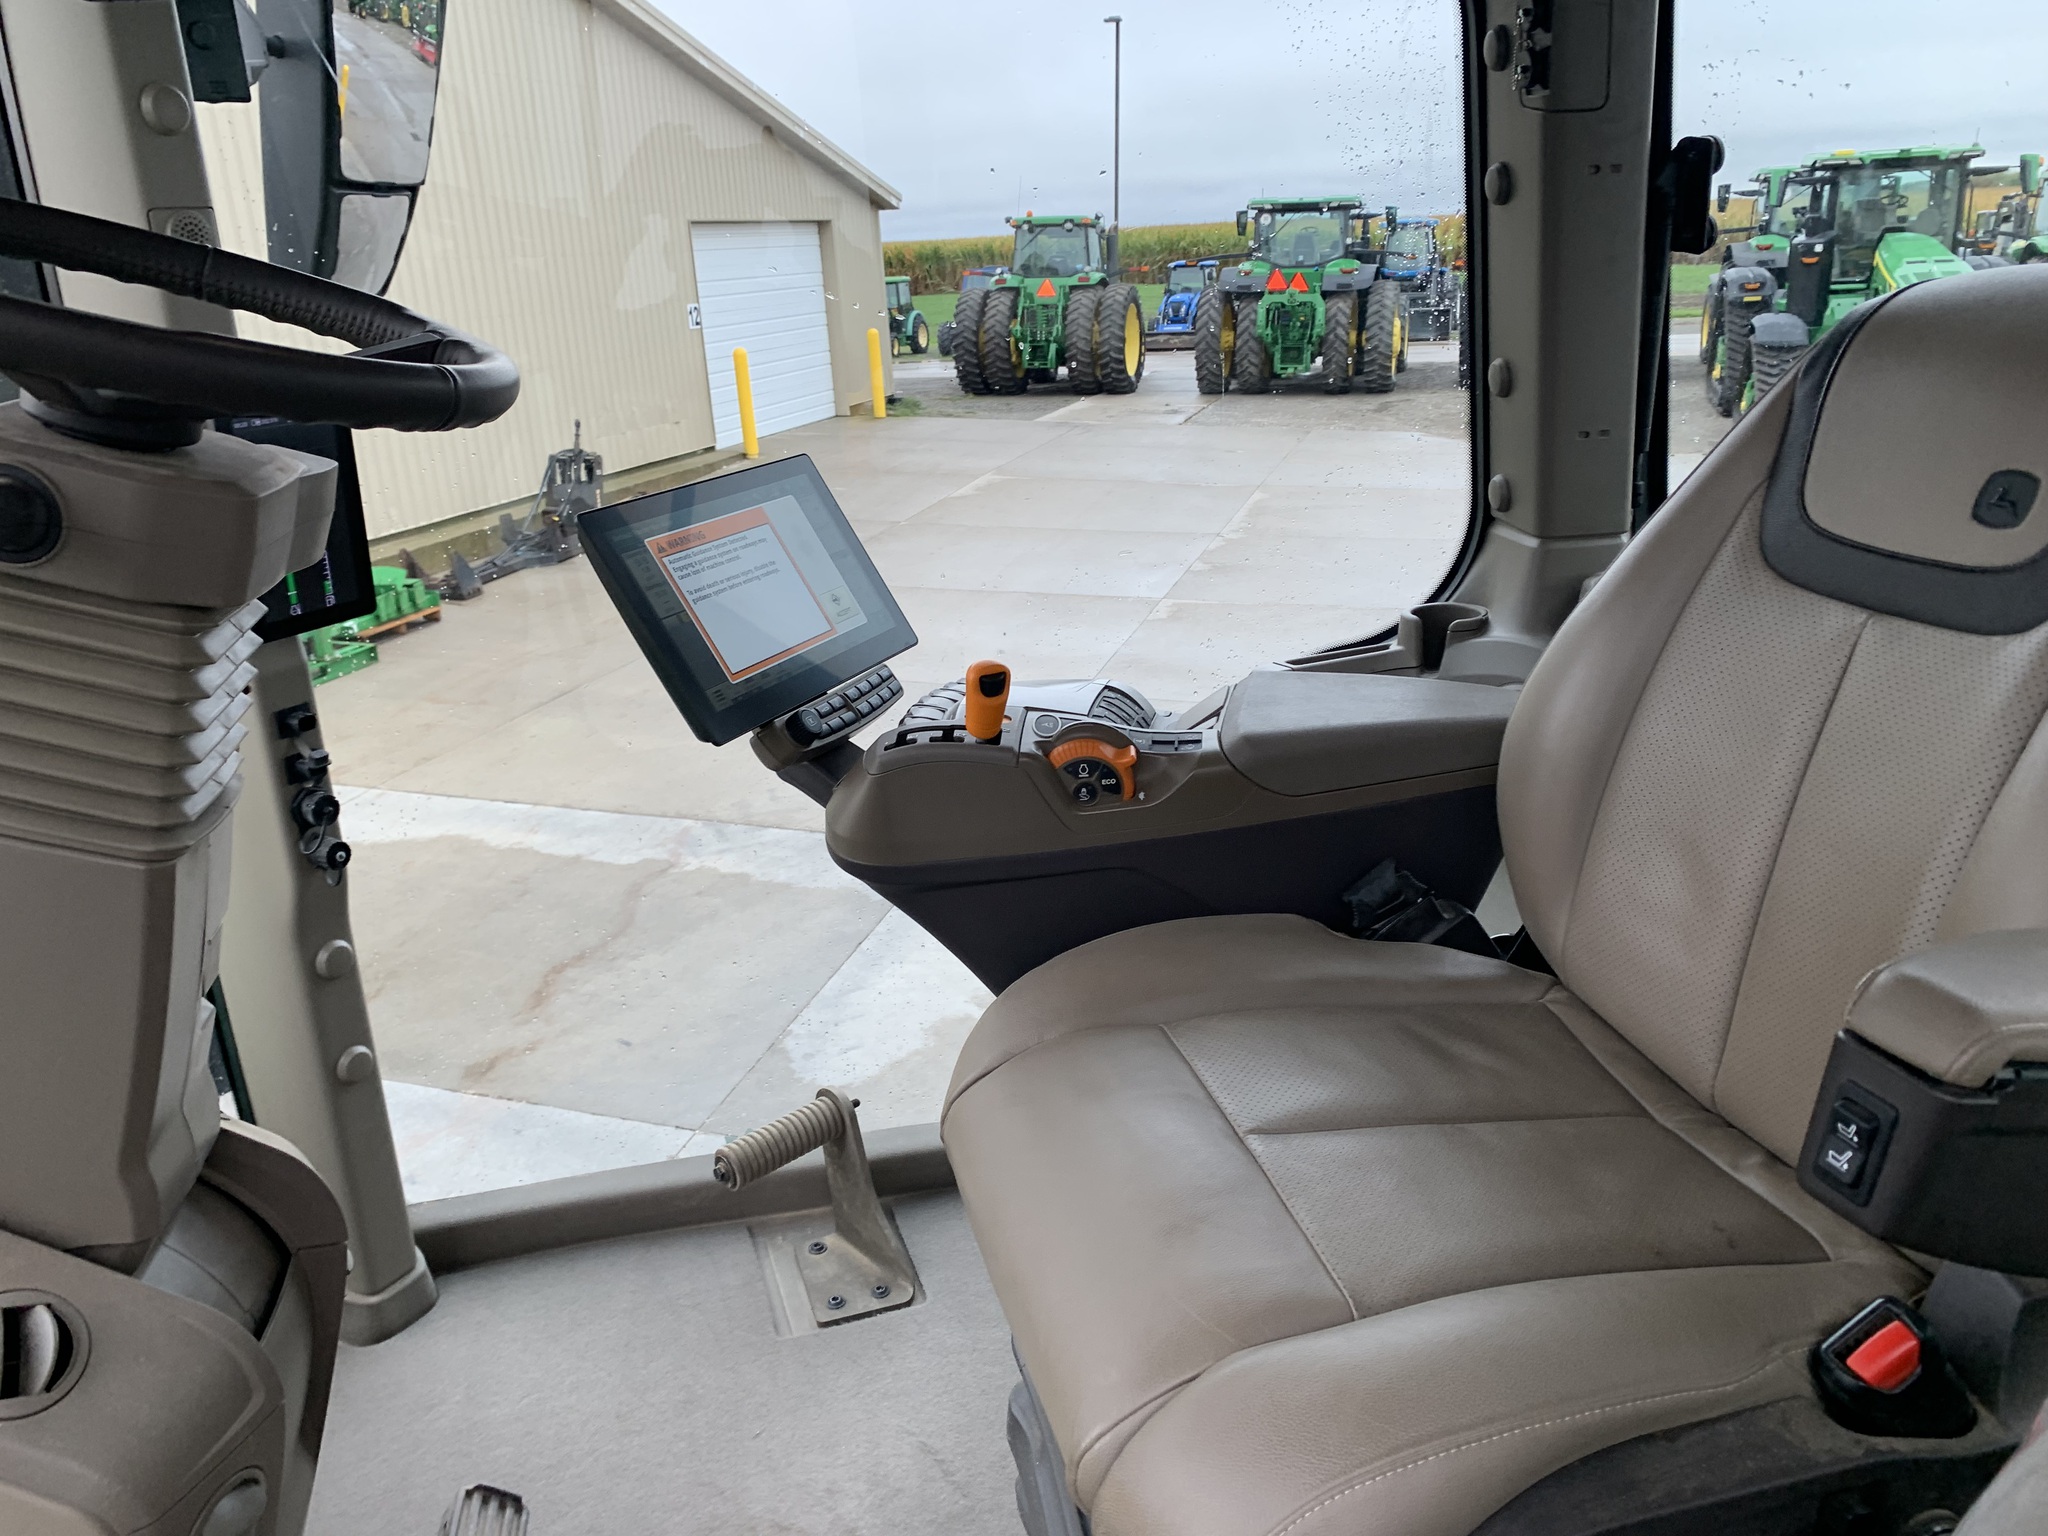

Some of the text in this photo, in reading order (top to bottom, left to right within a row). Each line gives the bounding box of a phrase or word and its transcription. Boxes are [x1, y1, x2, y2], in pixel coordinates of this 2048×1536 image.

[689, 306, 701, 327] 12
[667, 531, 706, 550] WARNING
[672, 562, 695, 574] Engaging
[677, 572, 692, 580] cause
[706, 560, 725, 570] machine
[692, 592, 714, 605] guidance
[712, 586, 729, 597] system
[728, 581, 743, 590] before
[693, 585, 706, 594] avoid
[706, 580, 720, 589] death
